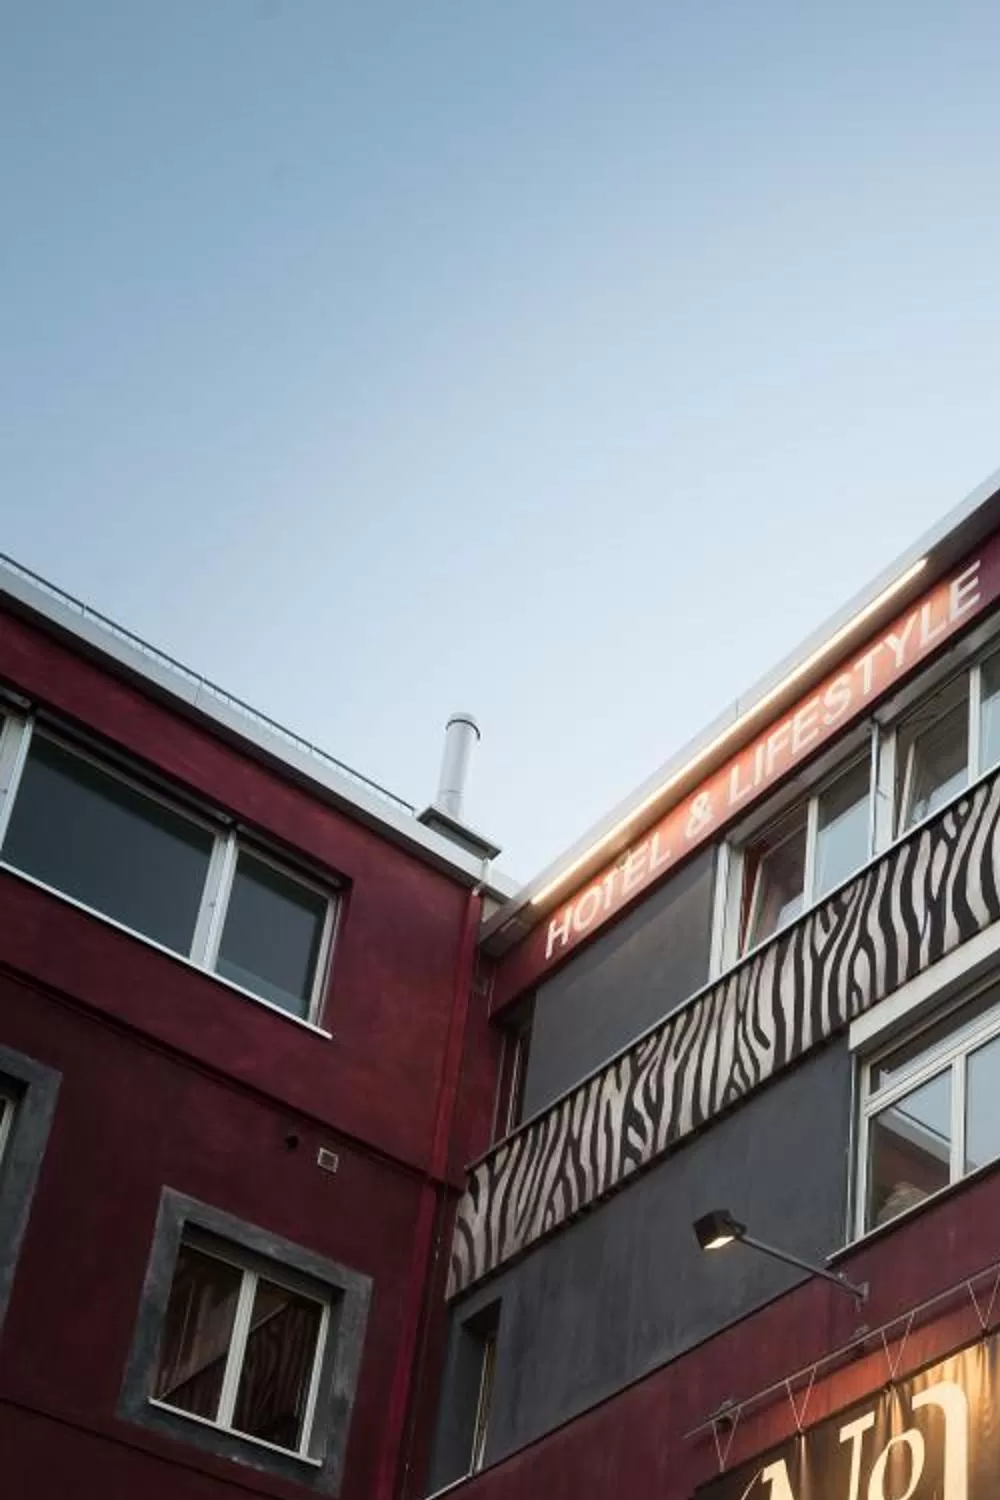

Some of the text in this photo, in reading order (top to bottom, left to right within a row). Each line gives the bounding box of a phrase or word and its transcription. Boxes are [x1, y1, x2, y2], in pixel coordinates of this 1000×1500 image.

[545, 559, 981, 959] HOTEL & LIFESTYLE
